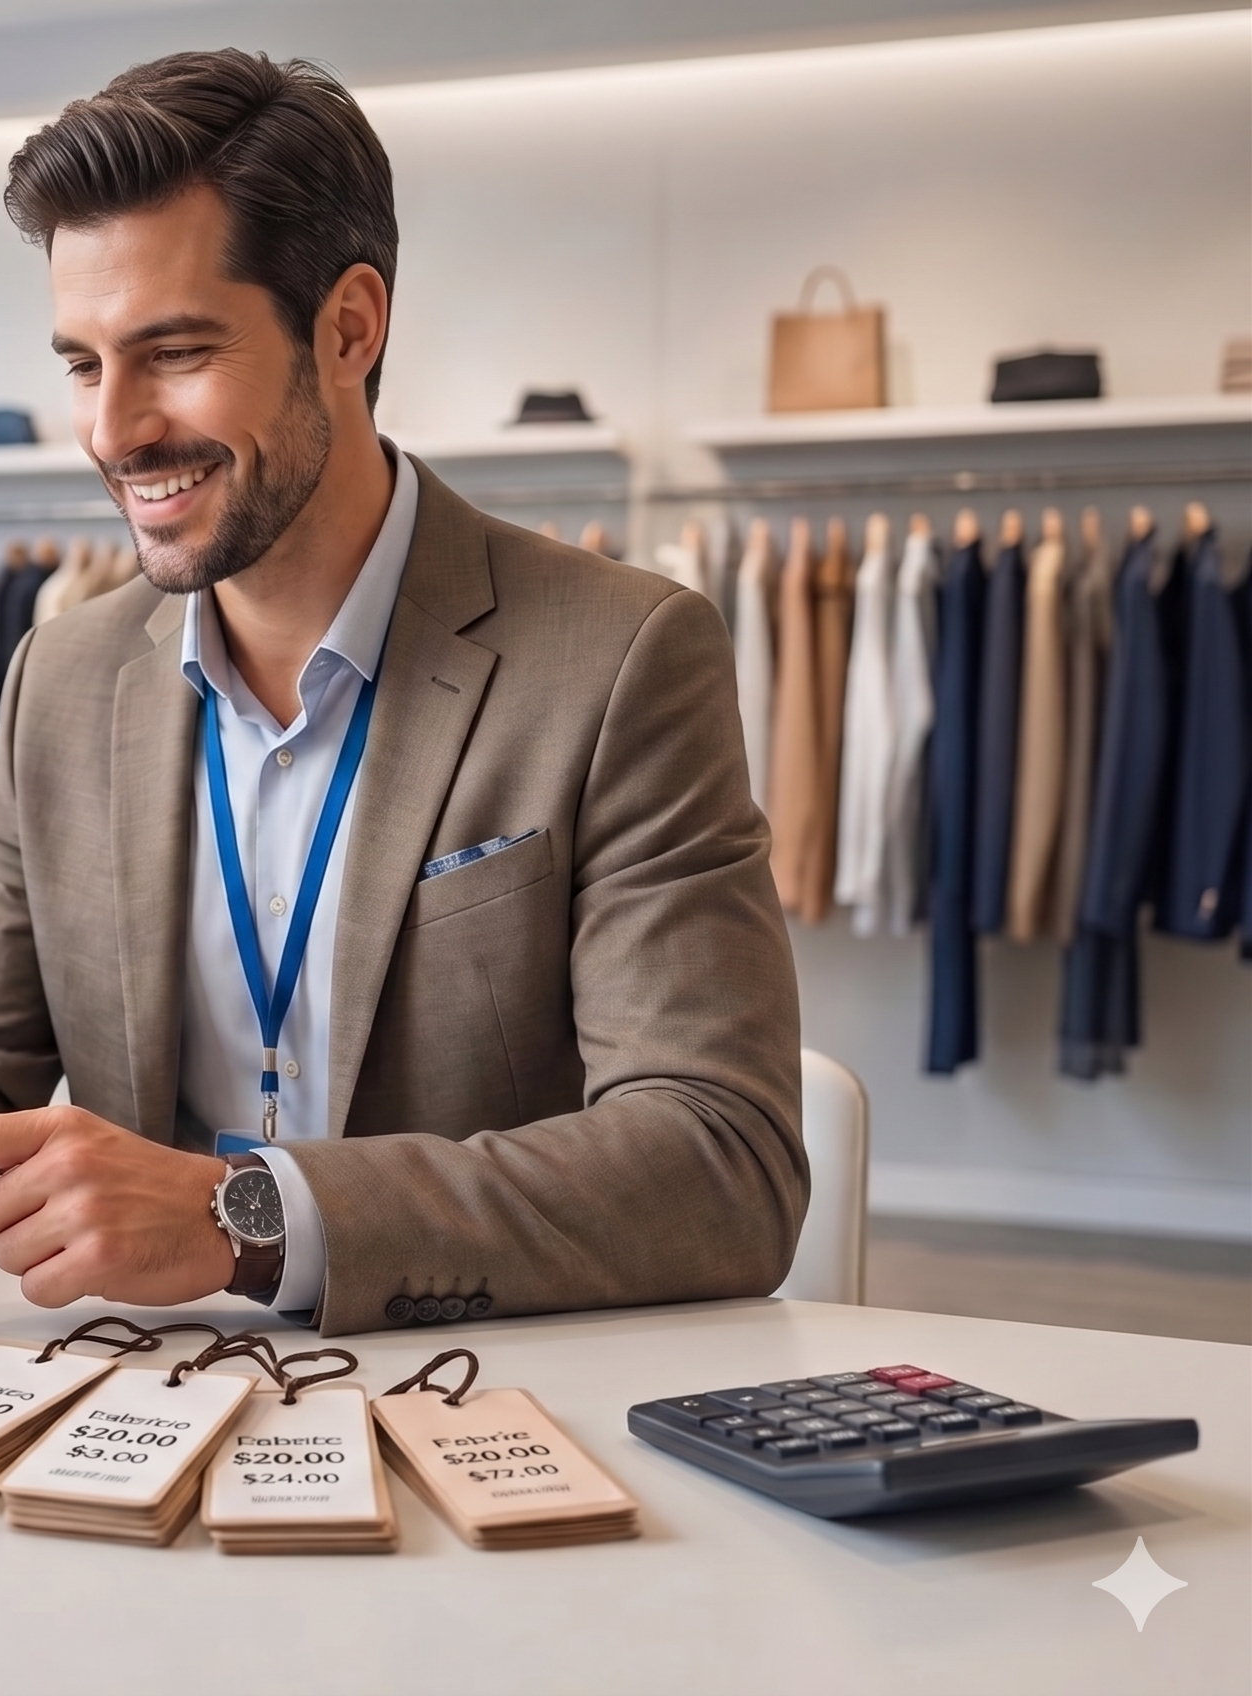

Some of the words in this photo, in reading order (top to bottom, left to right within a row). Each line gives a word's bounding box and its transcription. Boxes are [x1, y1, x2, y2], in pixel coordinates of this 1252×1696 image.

[69, 1425, 178, 1448] $20.00
[65, 1444, 149, 1465] $3.00
[233, 1450, 345, 1467] $20.00
[442, 1444, 551, 1467] $20.00
[242, 1473, 340, 1486] $24.00
